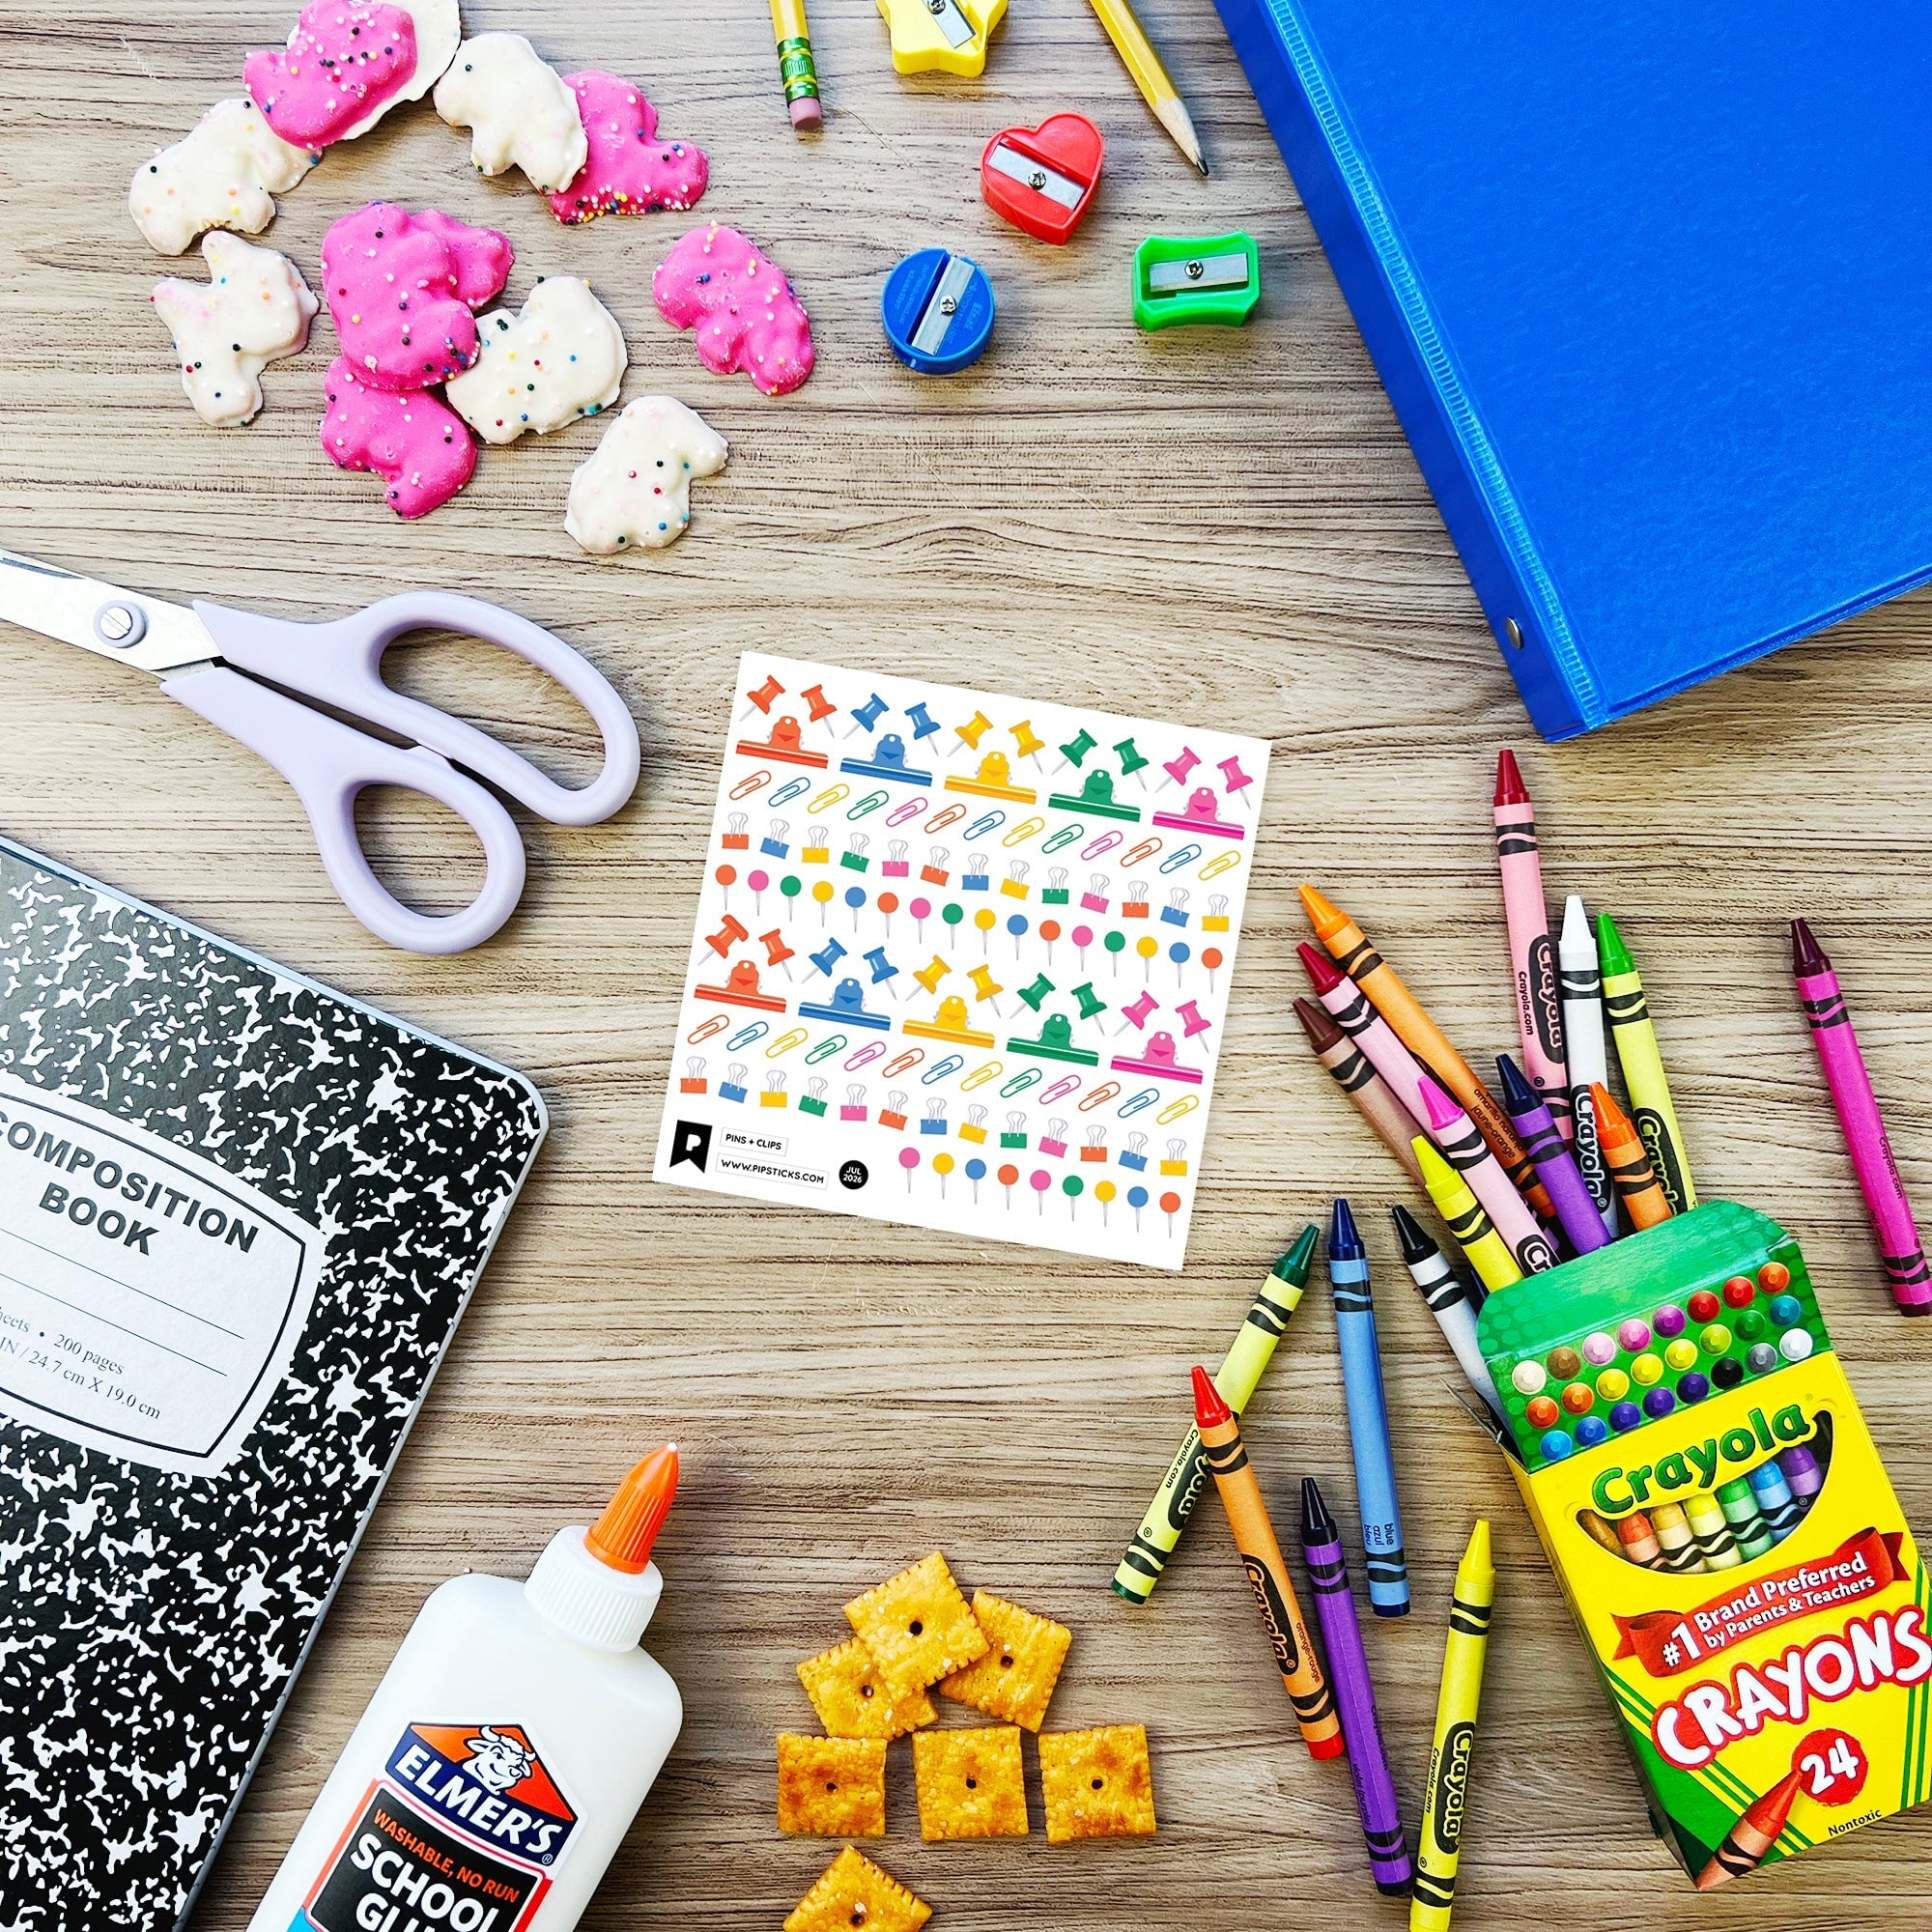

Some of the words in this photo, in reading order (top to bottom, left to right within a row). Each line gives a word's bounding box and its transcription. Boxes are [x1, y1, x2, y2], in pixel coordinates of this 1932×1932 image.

[1518, 971, 1534, 1036] Crayola.com
[1537, 942, 1562, 1048] Crayola
[1470, 1104, 1516, 1159] jaune-orange
[1474, 1089, 1500, 1121] amarillo
[721, 1159, 824, 1184] WWW.PIPSTICKS.COM
[725, 1133, 747, 1145] PINS
[756, 1138, 781, 1151] CLIPS
[845, 1166, 862, 1176] JUL
[1575, 1092, 1605, 1199] Crayola
[1879, 1136, 1903, 1199] Crayola.com
[842, 1173, 863, 1183] 2026
[39, 1182, 159, 1256] BOOK
[0, 1307, 30, 1333] eets
[54, 1333, 82, 1355] 200
[81, 1350, 125, 1375] pages
[28, 1350, 63, 1373] 24.7
[63, 1369, 85, 1385] cm
[87, 1377, 103, 1393] X
[106, 1385, 136, 1407] 19.0
[138, 1403, 160, 1419] cm
[1165, 1429, 1198, 1489] Crayola.com
[1592, 1404, 1811, 1514] Crayola
[1373, 1525, 1384, 1546] azul
[1384, 1522, 1394, 1546] blue
[1244, 1562, 1288, 1660] Crayola
[1662, 1621, 1701, 1667] #1
[1693, 1586, 1762, 1633] Brand
[1760, 1550, 1868, 1602] Preferred
[1704, 1631, 1725, 1649] by
[1726, 1602, 1787, 1637] Parents
[1788, 1596, 1804, 1612] &
[1802, 1575, 1876, 1606] Teachers
[1295, 1622, 1321, 1683] orange-rouge
[1656, 1609, 1932, 1766] CRAYONS
[1425, 1747, 1440, 1814] Crayola.com
[1442, 1730, 1474, 1837] Crayola
[1801, 1738, 1859, 1794] 24
[394, 1744, 562, 1855] ELMER'S
[1828, 1808, 1882, 1836] Nontoxic
[373, 1807, 454, 1878] WASHABLE,
[456, 1865, 483, 1888] NO
[482, 1879, 521, 1904] RUN
